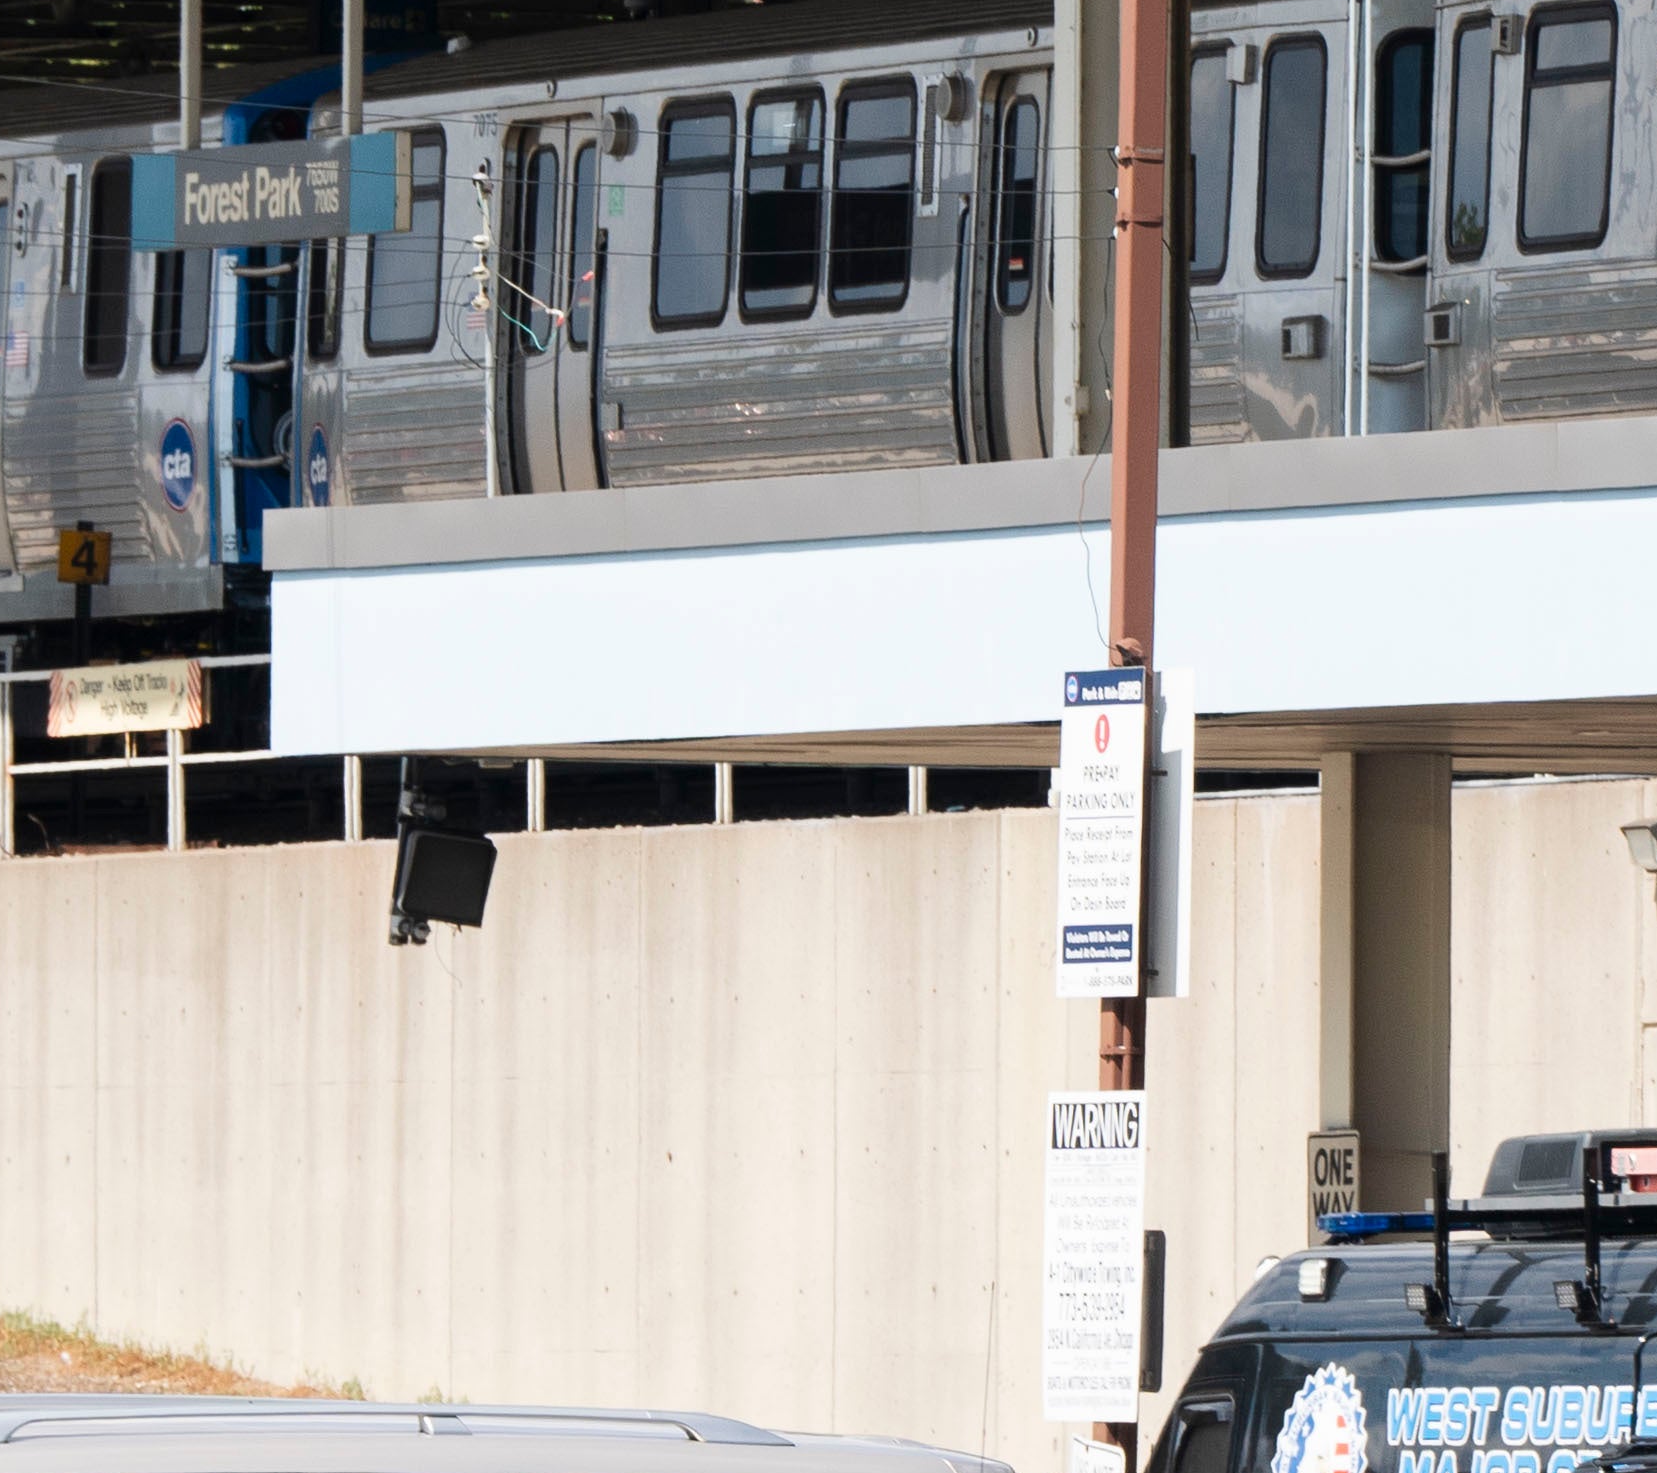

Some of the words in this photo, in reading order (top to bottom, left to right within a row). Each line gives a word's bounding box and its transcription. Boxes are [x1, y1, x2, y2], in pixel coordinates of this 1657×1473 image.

[472, 112, 499, 137] 7075
[185, 170, 250, 226] Forest
[253, 165, 302, 220] Park
[162, 449, 191, 480] cta
[309, 450, 328, 484] cta
[71, 538, 99, 570] 4
[1066, 793, 1108, 809] PARKING
[1054, 1102, 1139, 1149] WARNING
[1313, 1147, 1354, 1187] ONE
[1313, 1190, 1355, 1219] WAY
[1387, 1386, 1499, 1446] WEST
